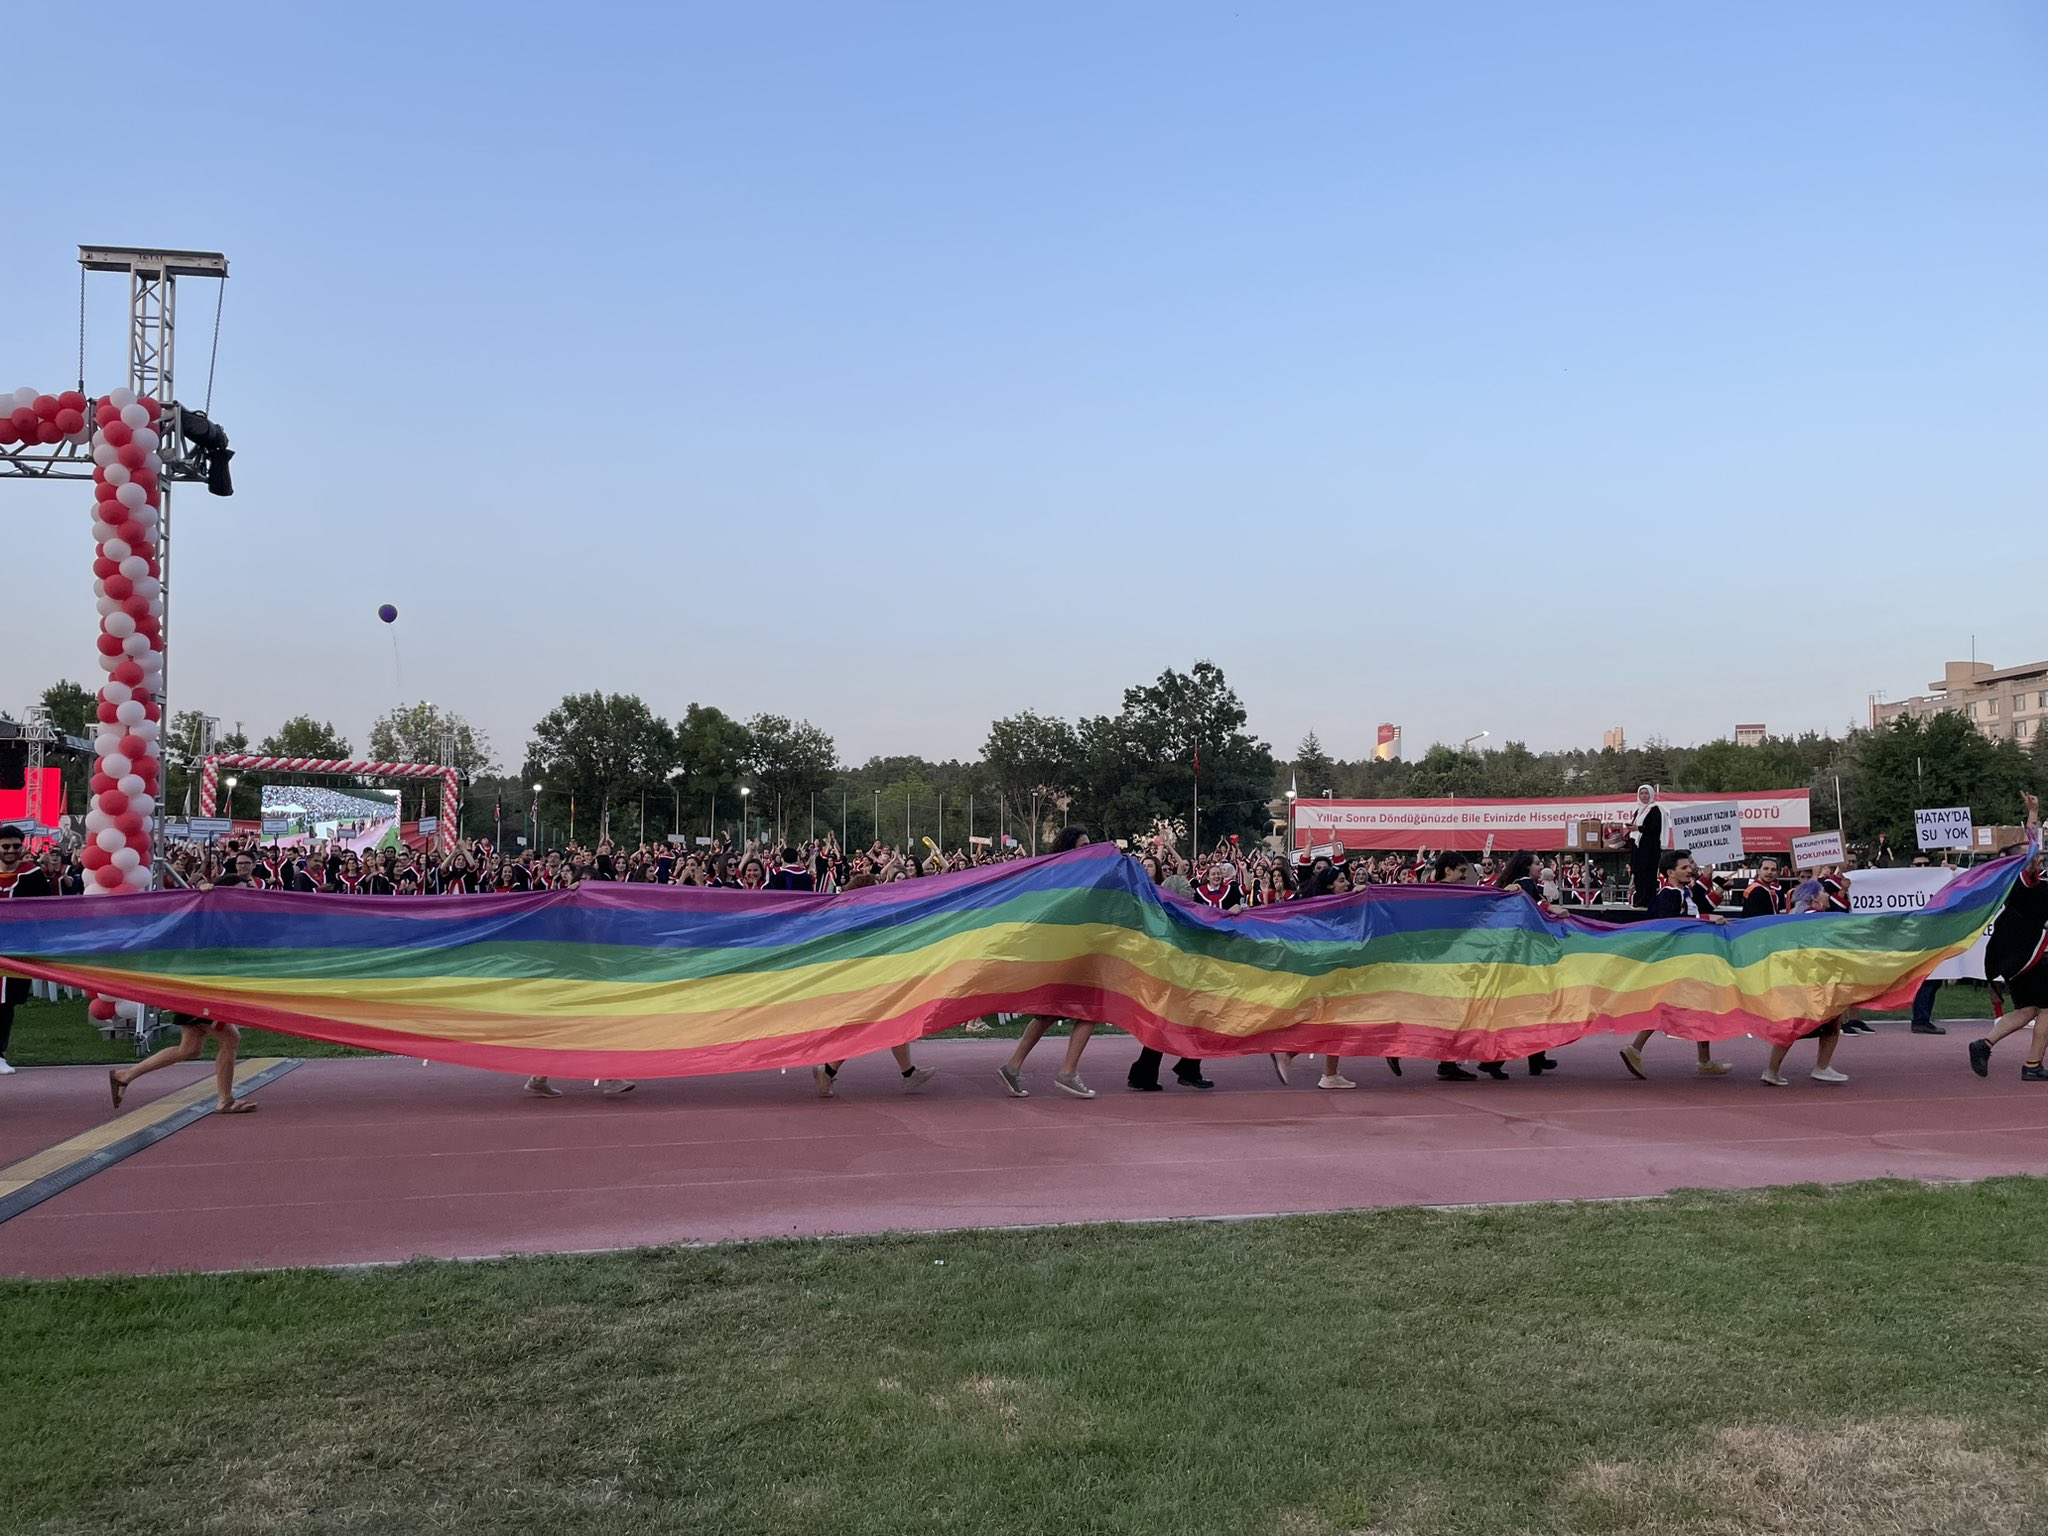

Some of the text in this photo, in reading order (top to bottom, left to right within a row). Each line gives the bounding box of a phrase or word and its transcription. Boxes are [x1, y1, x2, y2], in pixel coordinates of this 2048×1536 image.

[1317, 813, 1343, 823] Yıllar
[1346, 813, 1376, 823] Sonra
[1379, 813, 1459, 825] Döndüğünüzde
[1461, 813, 1481, 823] Bile
[1484, 812, 1527, 823] Evinizde
[1674, 810, 1737, 826] BENİM PANKART YAZIM DA
[1915, 811, 1970, 824] HATAY'DA
[1683, 824, 1731, 838] DİPLOMAM GİBİ SON
[1921, 829, 1937, 841] SU
[1944, 828, 1968, 840] YOK
[1688, 839, 1713, 850] DAKİKAYA
[1797, 849, 1840, 861] DOKUNMA!
[1852, 895, 1883, 909] 2023
[1886, 891, 1925, 908] ODTÜ
